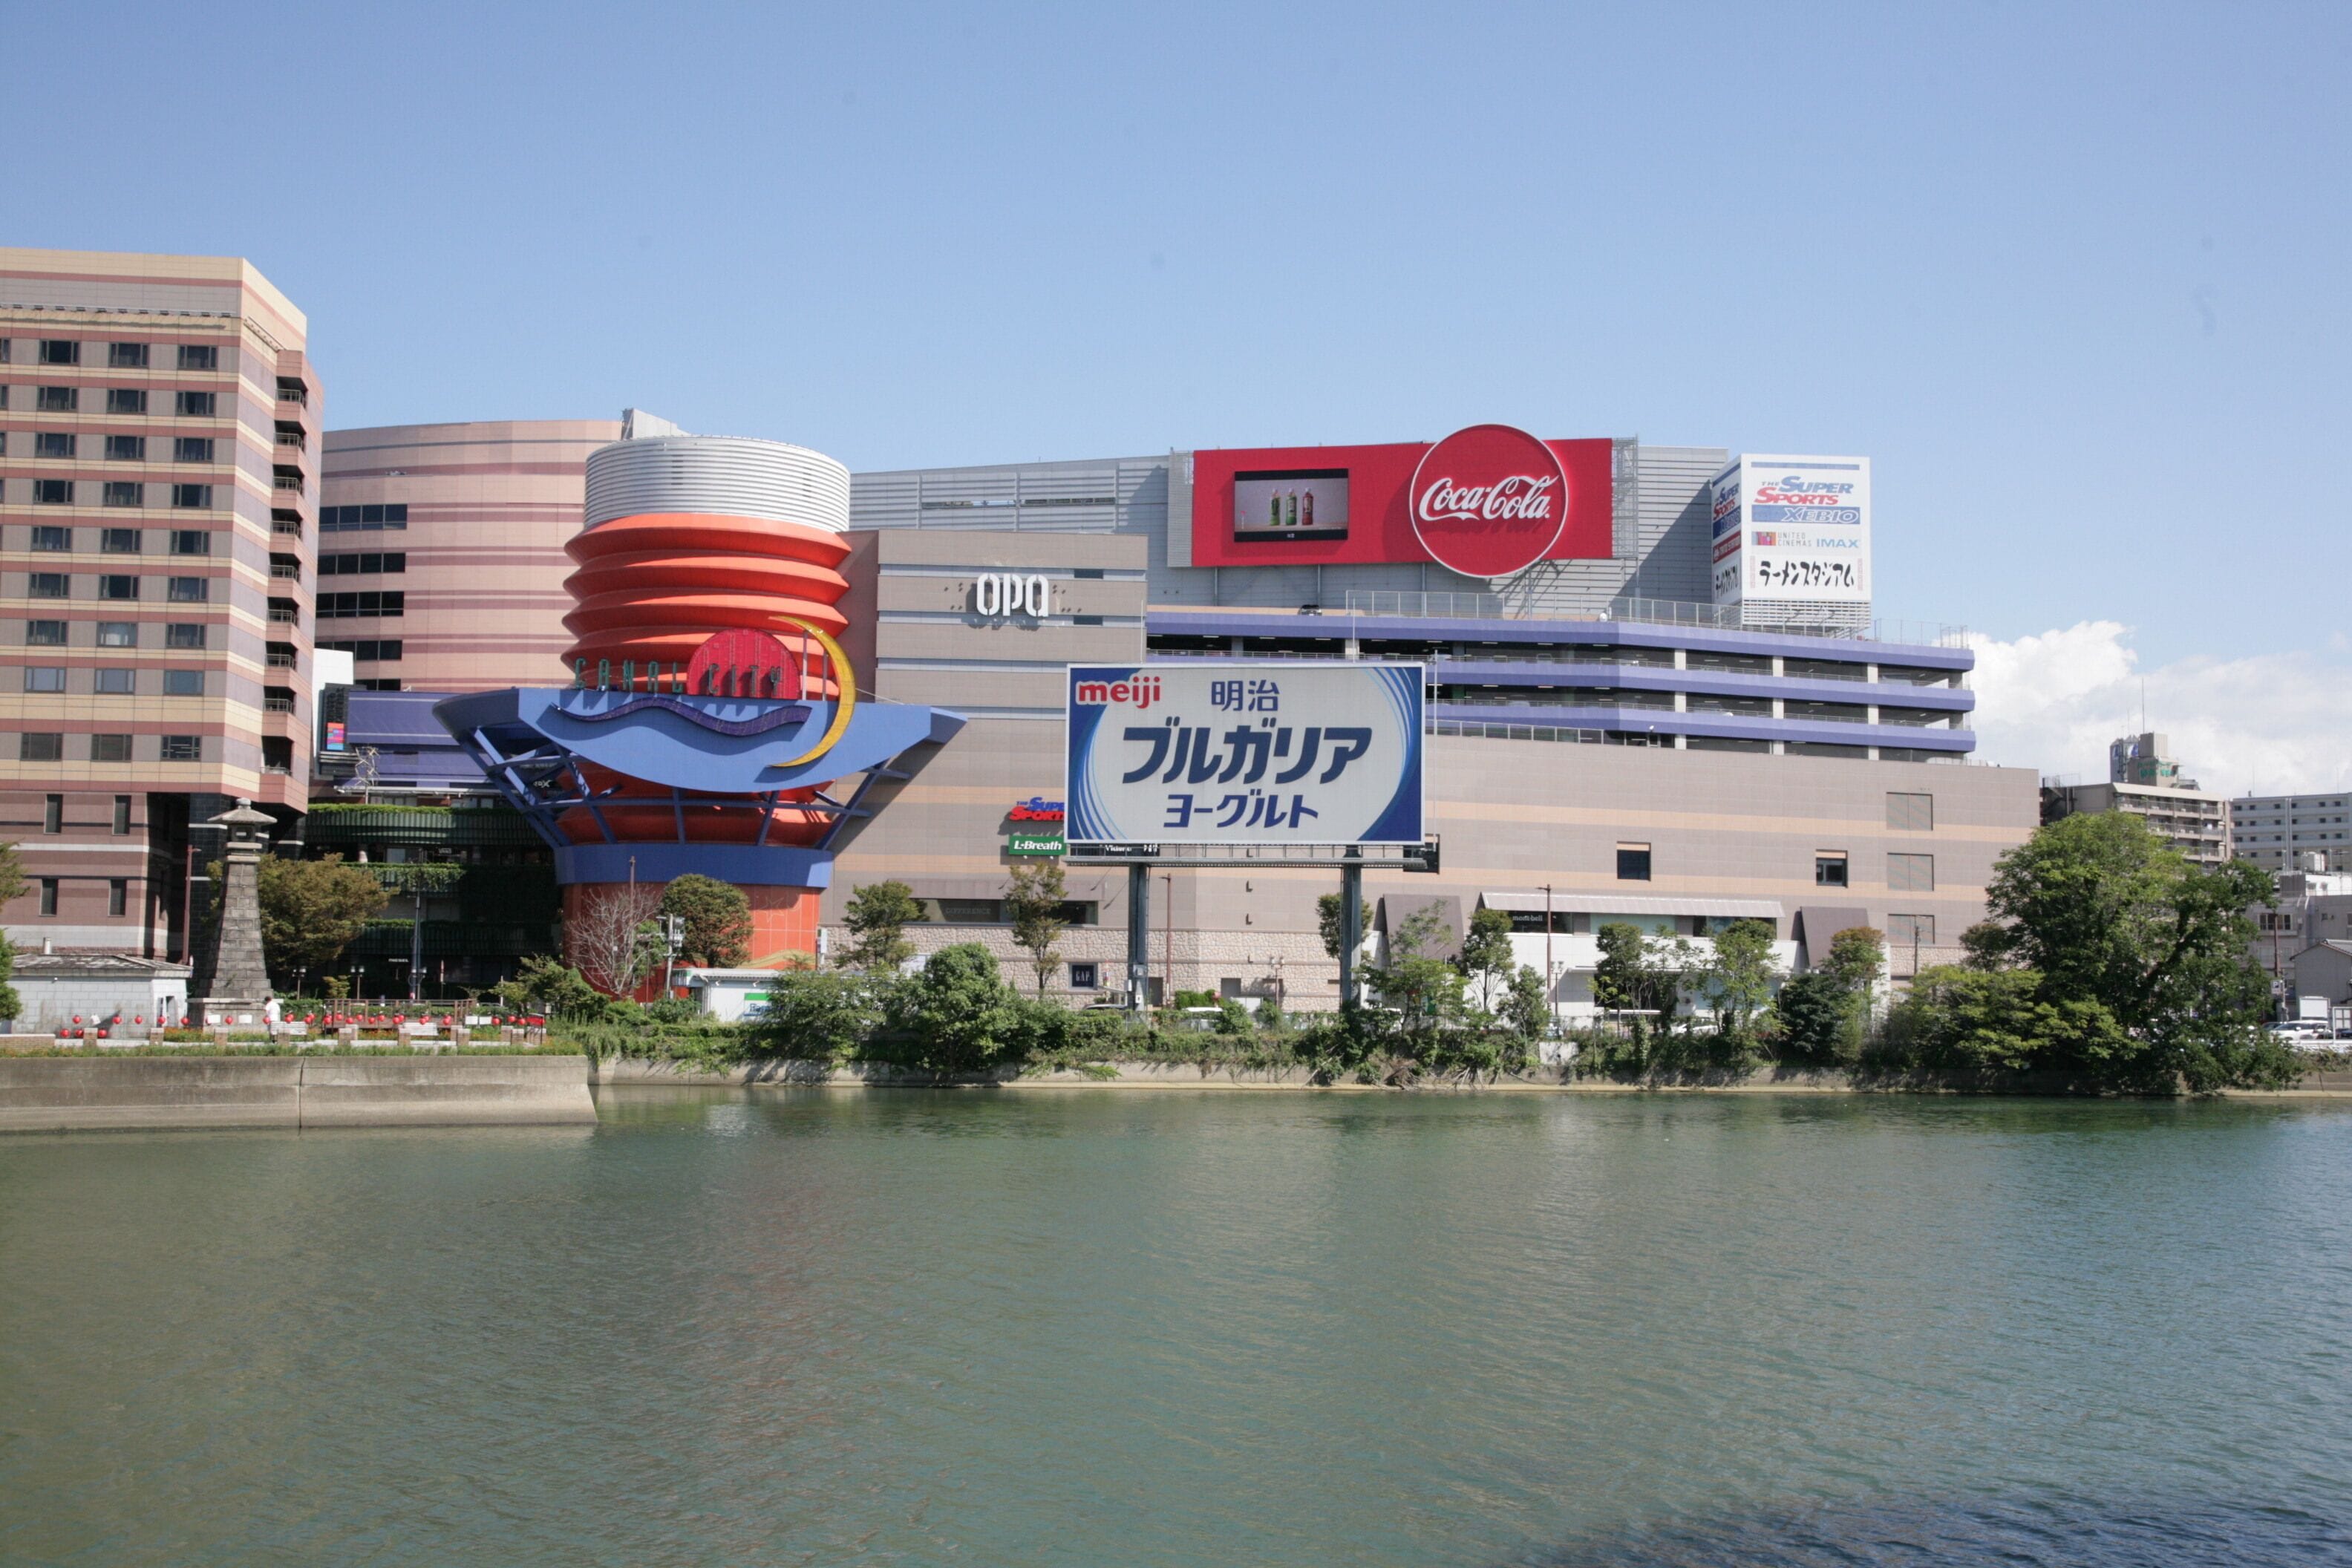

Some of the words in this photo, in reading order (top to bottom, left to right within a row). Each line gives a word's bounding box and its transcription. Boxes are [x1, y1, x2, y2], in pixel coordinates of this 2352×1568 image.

[1419, 475, 1559, 521] Coca-Cola
[1754, 487, 1839, 505] SPORTS
[1778, 476, 1854, 494] SUPER
[1781, 507, 1859, 524] XEBIO
[1817, 539, 1859, 548] IMAX
[1760, 561, 1854, 587] ラーメンスタジアム
[575, 657, 683, 693] CANAL
[708, 663, 781, 696] CITY
[1077, 676, 1160, 709] meiji
[1211, 679, 1280, 711] 明治
[1123, 716, 1373, 784] ブルガリア
[1010, 806, 1065, 821] SPORT
[1028, 797, 1065, 811] SUPE
[1163, 788, 1319, 828] ヨーグルト
